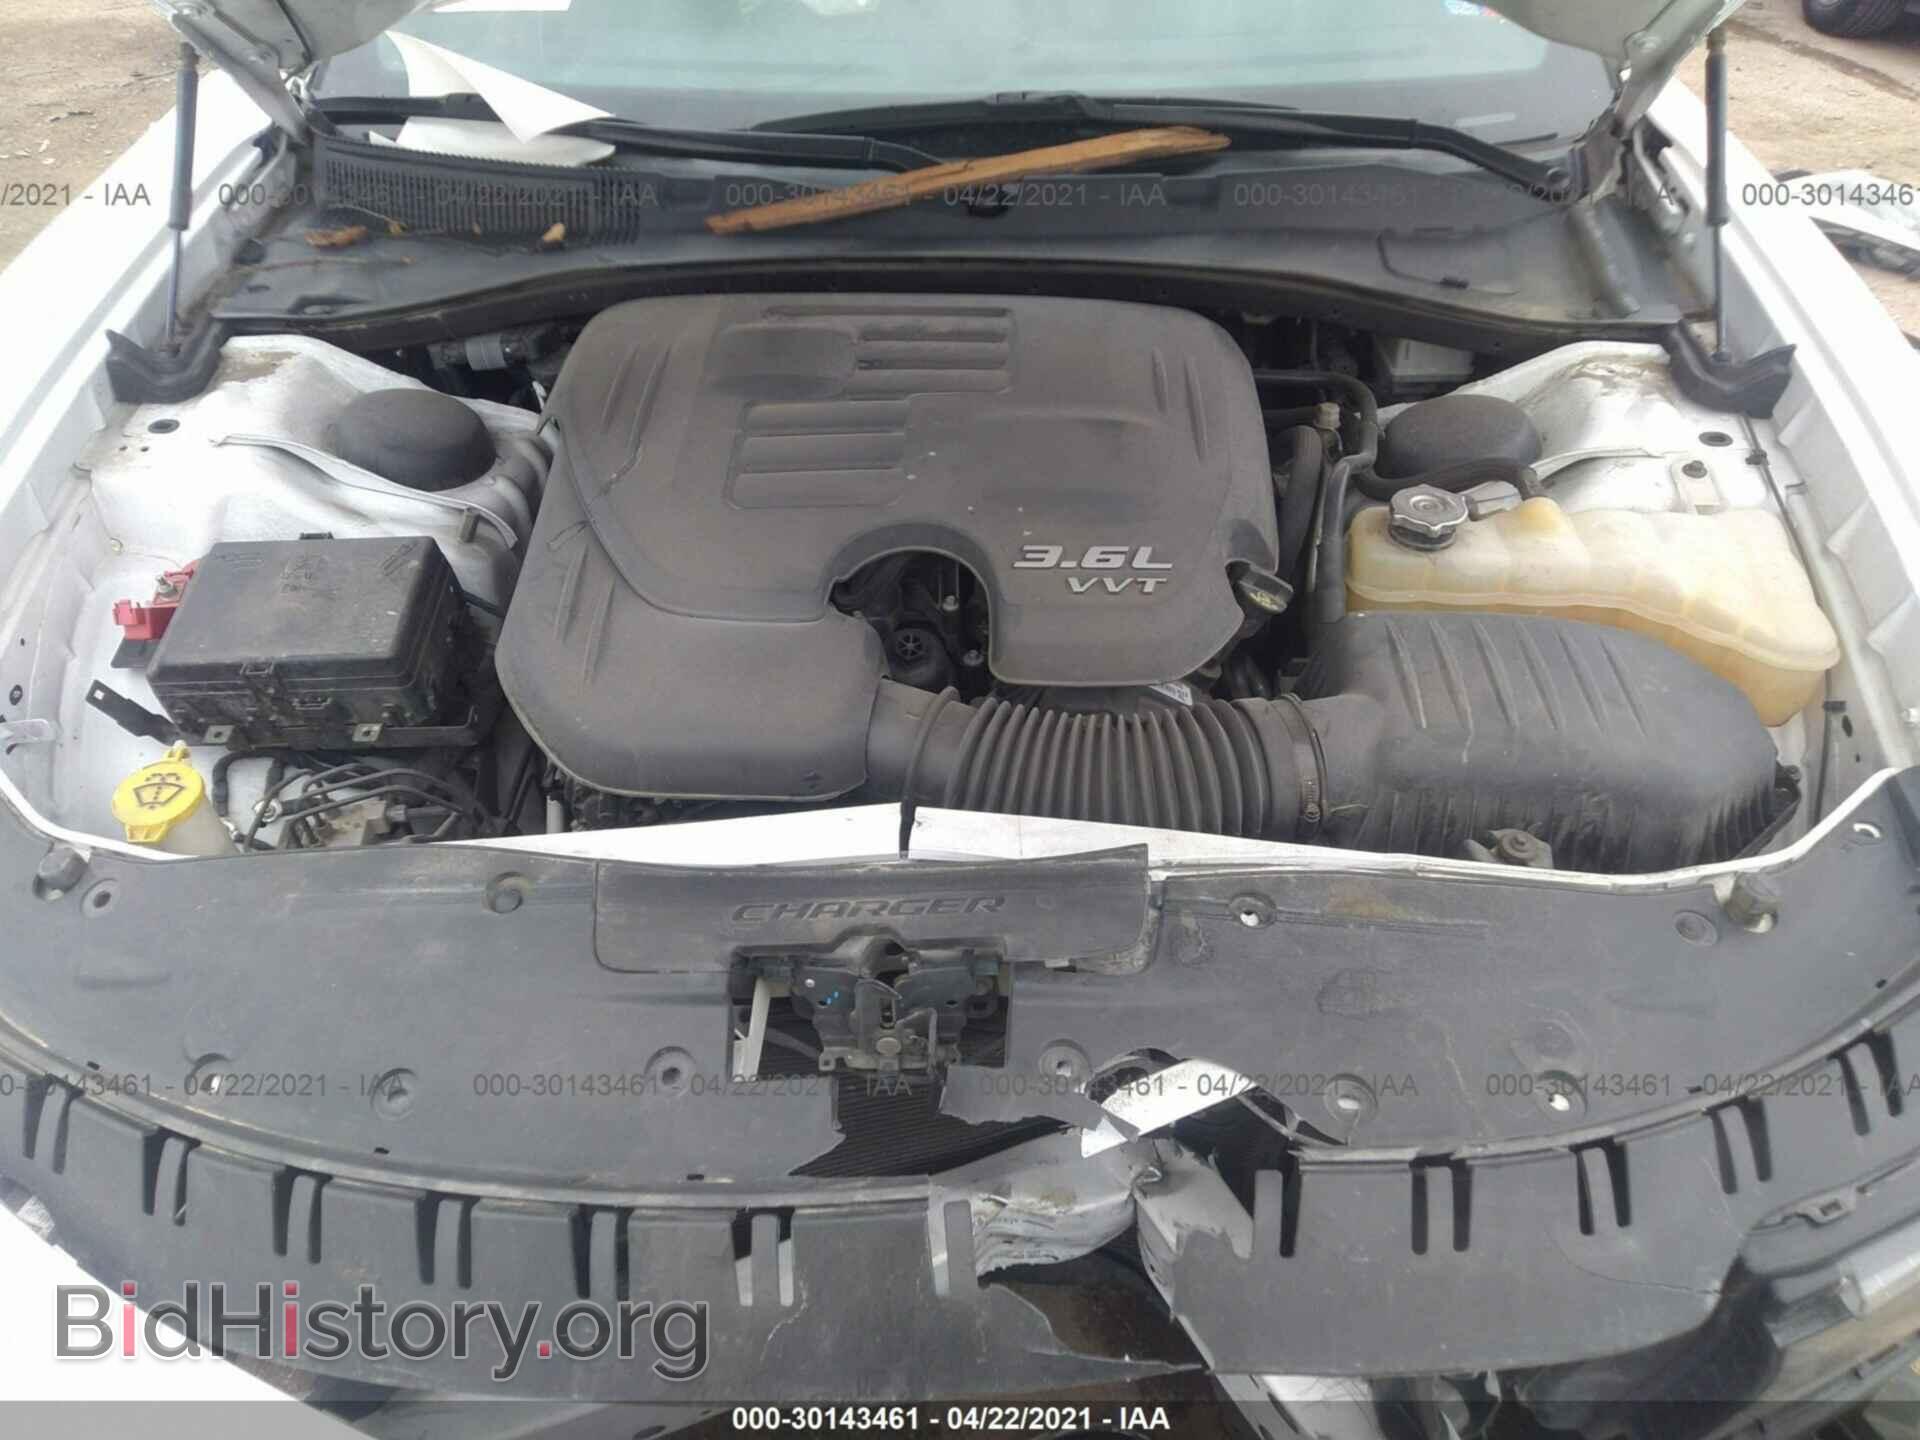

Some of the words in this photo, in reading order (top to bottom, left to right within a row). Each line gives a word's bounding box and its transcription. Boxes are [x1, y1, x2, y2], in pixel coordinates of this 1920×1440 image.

[1013, 545, 1172, 569] 3.6L
[1066, 577, 1168, 593] VVT
[731, 896, 1005, 922] CHARGER
